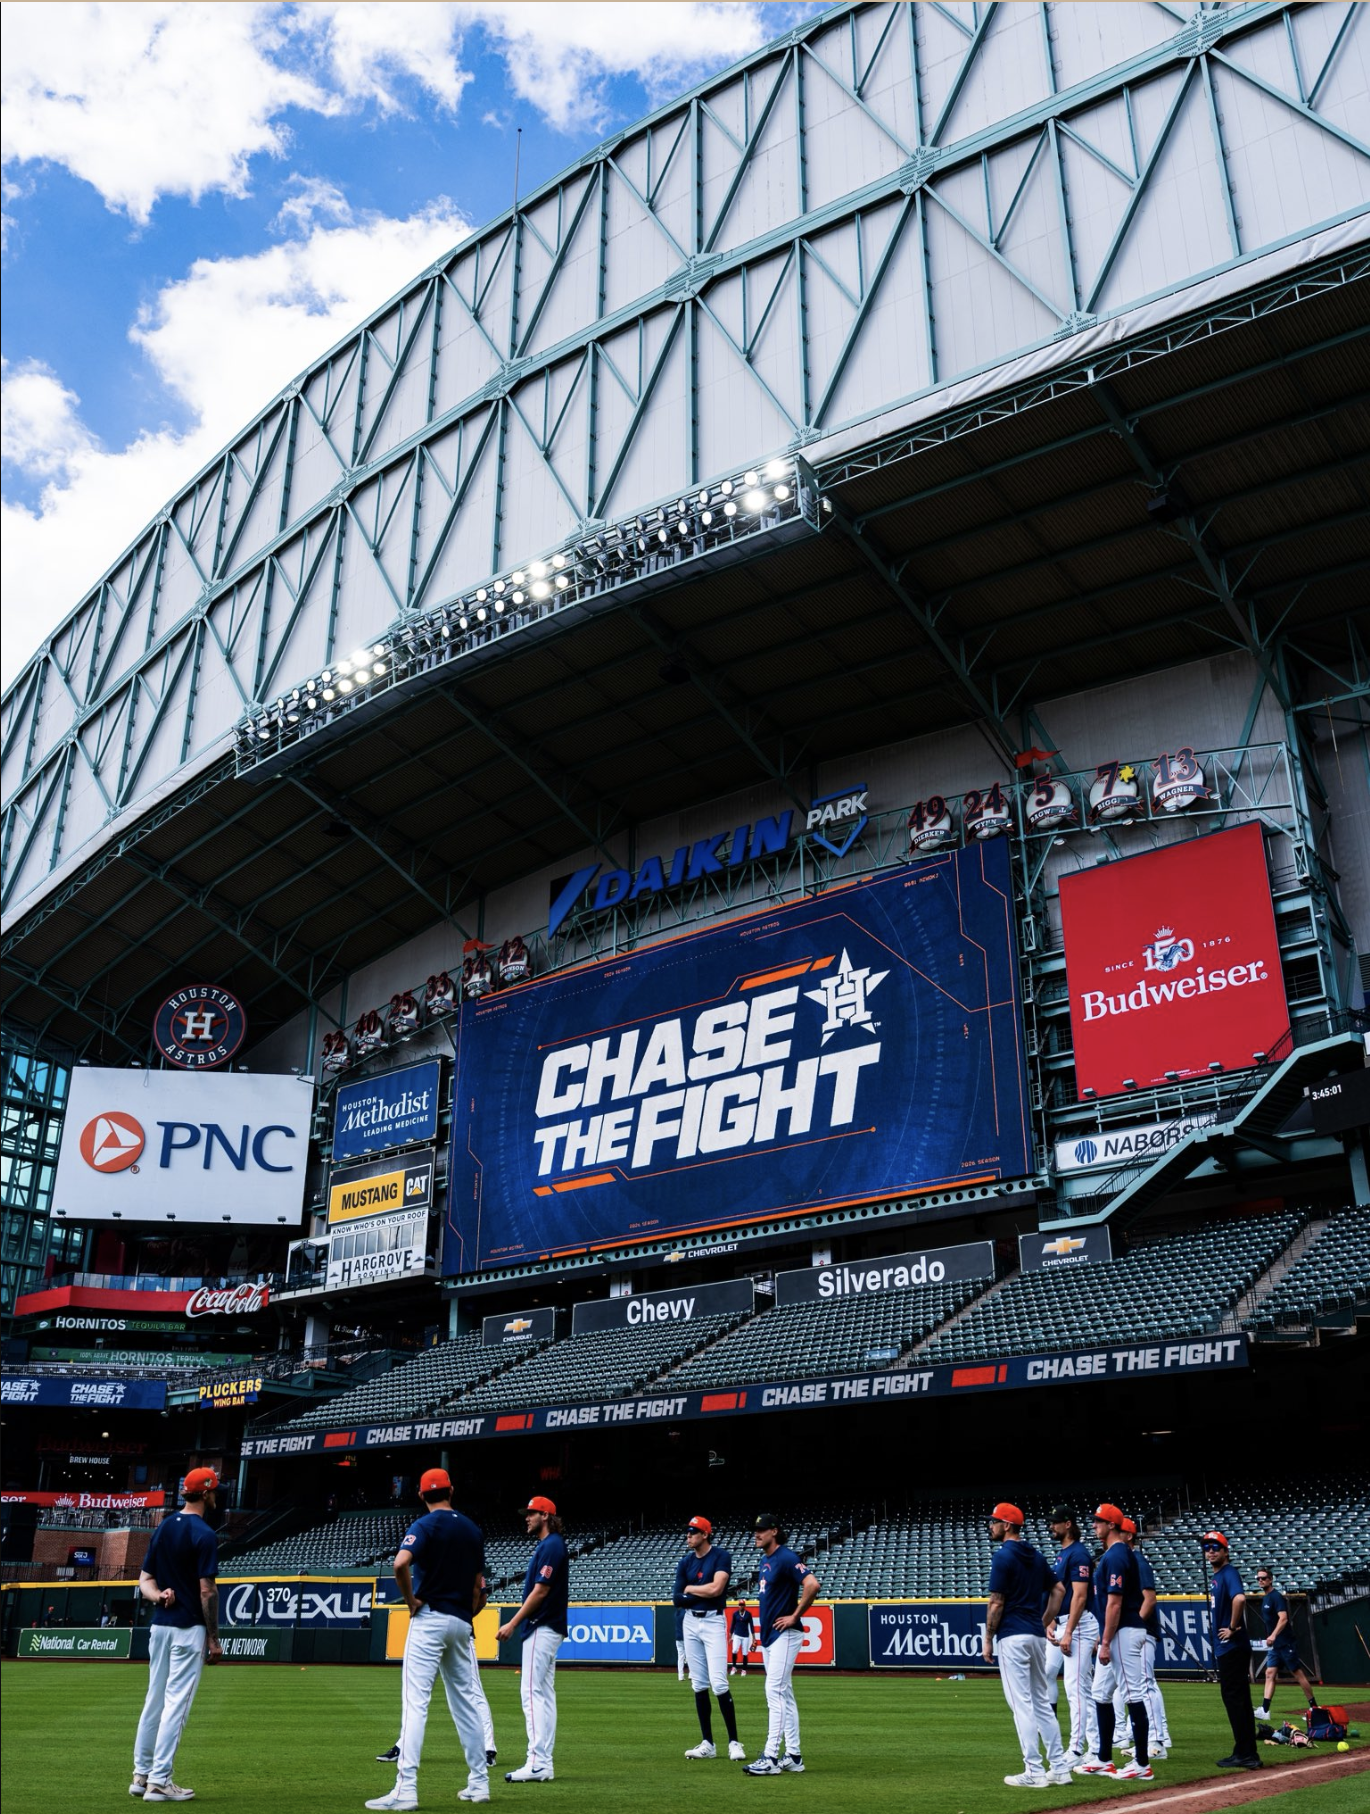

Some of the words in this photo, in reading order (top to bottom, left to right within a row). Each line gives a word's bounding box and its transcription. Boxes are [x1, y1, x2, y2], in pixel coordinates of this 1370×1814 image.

[1096, 760, 1119, 797] 7
[1153, 747, 1198, 788] 13
[1034, 773, 1055, 807] 5
[1160, 786, 1194, 800] WAGNER
[806, 791, 868, 830] PARK
[908, 796, 946, 832] 49
[964, 782, 1005, 824] 24
[593, 810, 793, 911] DAIKIN
[1202, 936, 1231, 948] 1876
[1105, 961, 1134, 973] SINCE
[168, 988, 237, 1012] HOUSTON
[1080, 960, 1264, 1022] Budweiser
[181, 1011, 215, 1040] H
[165, 1043, 227, 1065] ASTROS
[535, 985, 799, 1118] CHASE
[1312, 1083, 1343, 1101] 3:45:01
[341, 1091, 430, 1133] Methodist
[342, 1096, 378, 1112] HOUSTON
[534, 1107, 635, 1176] THE
[631, 1042, 882, 1169] FIGHT
[363, 1123, 393, 1138] LEADING
[394, 1114, 429, 1129] MEDICINE
[157, 1121, 296, 1172] PNC
[341, 1182, 398, 1211] MUSTANG
[405, 1174, 429, 1197] CAT
[332, 1225, 353, 1235] KNOW
[353, 1219, 376, 1232] WHO'S
[376, 1217, 387, 1227] ON
[387, 1214, 406, 1225] YOUR
[407, 1210, 426, 1220] ROOF
[687, 1243, 739, 1258] CHEVROLET
[1042, 1254, 1089, 1268] CHEVROLET
[341, 1249, 413, 1282] HARGROVE
[357, 1267, 395, 1279] ROOFING
[817, 1256, 946, 1298] Silverado
[626, 1298, 696, 1325] Chevy
[56, 1316, 127, 1331] HORNITOS
[130, 1321, 166, 1330] TEQUILA
[167, 1323, 187, 1331] BAR
[502, 1333, 534, 1343] CHEVROLET
[110, 1351, 173, 1363] HORNITOS
[176, 1355, 204, 1363] TEQUILA
[1026, 1354, 1107, 1381] CHASE
[1113, 1349, 1160, 1372] THE
[1163, 1340, 1241, 1367] FIGHT
[1, 1391, 39, 1401] FIGHT
[70, 1383, 115, 1394] CHASE
[86, 1394, 125, 1404] FIGHT
[198, 1378, 262, 1400] PLUCKERS
[762, 1378, 826, 1407] CHASE
[830, 1377, 871, 1401] THE
[872, 1371, 934, 1396] FIGHT
[213, 1397, 231, 1408] WING
[232, 1395, 246, 1406] BAR
[545, 1405, 600, 1428] CHASE
[603, 1404, 635, 1421] THE
[635, 1397, 688, 1418] FIGHT
[366, 1426, 412, 1444] CHASE
[414, 1424, 441, 1439] THE
[440, 1418, 485, 1436] FIGHT
[255, 1440, 279, 1454] THE
[278, 1435, 315, 1452] FIGHT
[69, 1456, 89, 1464] BREW
[89, 1457, 110, 1465] HOUSE
[78, 1493, 148, 1509] Budweiser
[266, 1587, 290, 1602] 370
[267, 1591, 386, 1619] LEXUS
[880, 1614, 938, 1625] HOUSTON
[40, 1636, 75, 1651] National
[77, 1639, 91, 1651] Car
[91, 1639, 118, 1651] Rental
[229, 1637, 269, 1656] NETWORK
